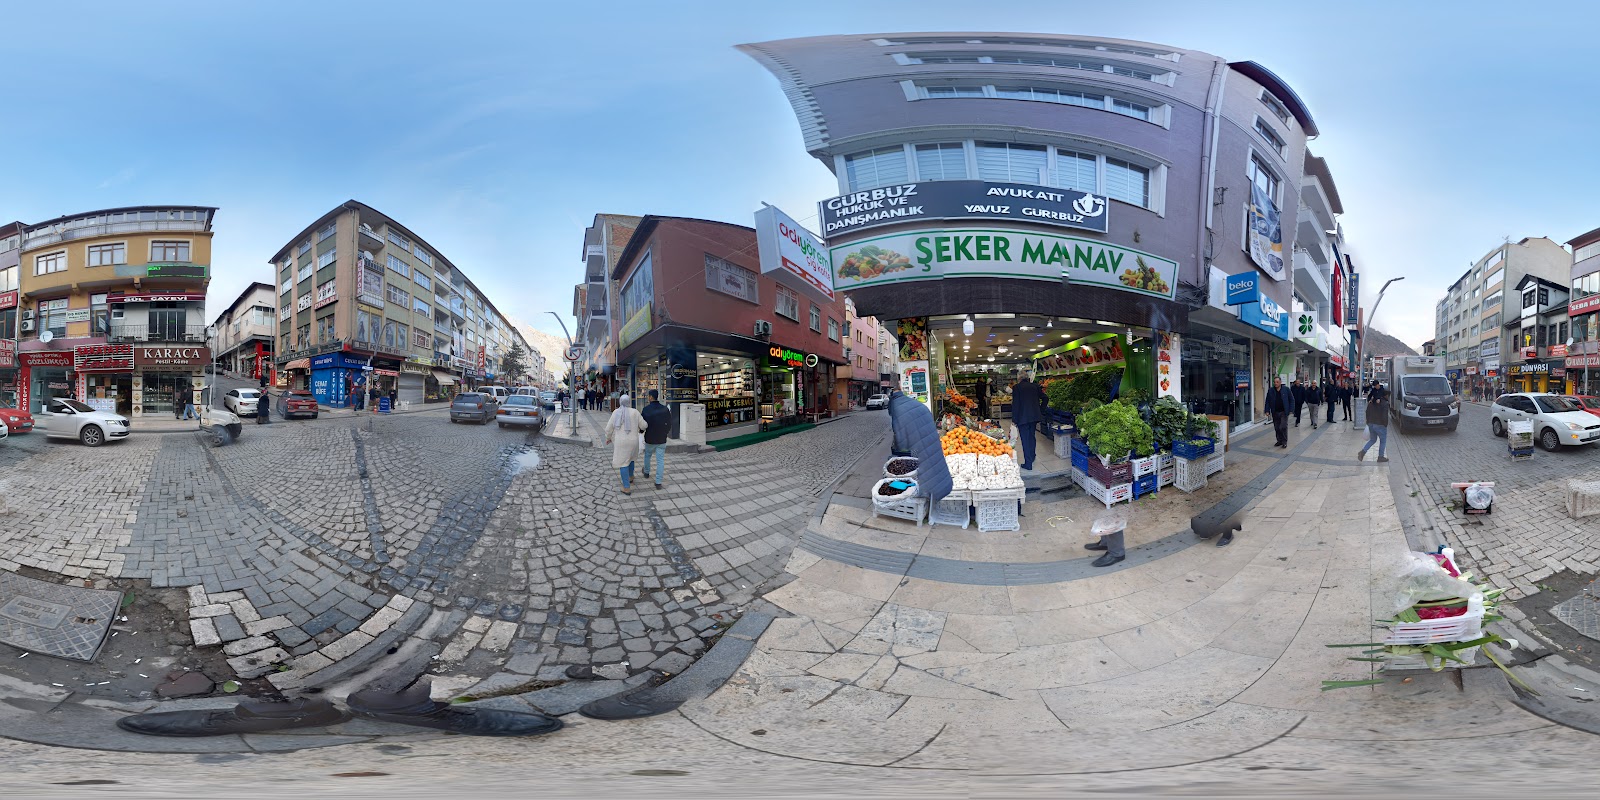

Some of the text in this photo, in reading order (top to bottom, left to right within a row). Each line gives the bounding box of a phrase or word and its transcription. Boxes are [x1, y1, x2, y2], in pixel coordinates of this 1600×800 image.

[836, 197, 908, 218] HUKUK VE
[964, 205, 1010, 214] YAVUZ
[826, 206, 924, 232] DANIŞMANLIK
[915, 236, 1012, 272] ŞEKER
[1229, 280, 1253, 290] beko
[1260, 294, 1280, 322] beko
[144, 348, 200, 358] KARACA
[770, 347, 803, 361] adıyörem
[1521, 363, 1548, 372] DÜNYASI
[17, 601, 57, 615] TELEKOM
[17, 610, 41, 620] TÜRK
